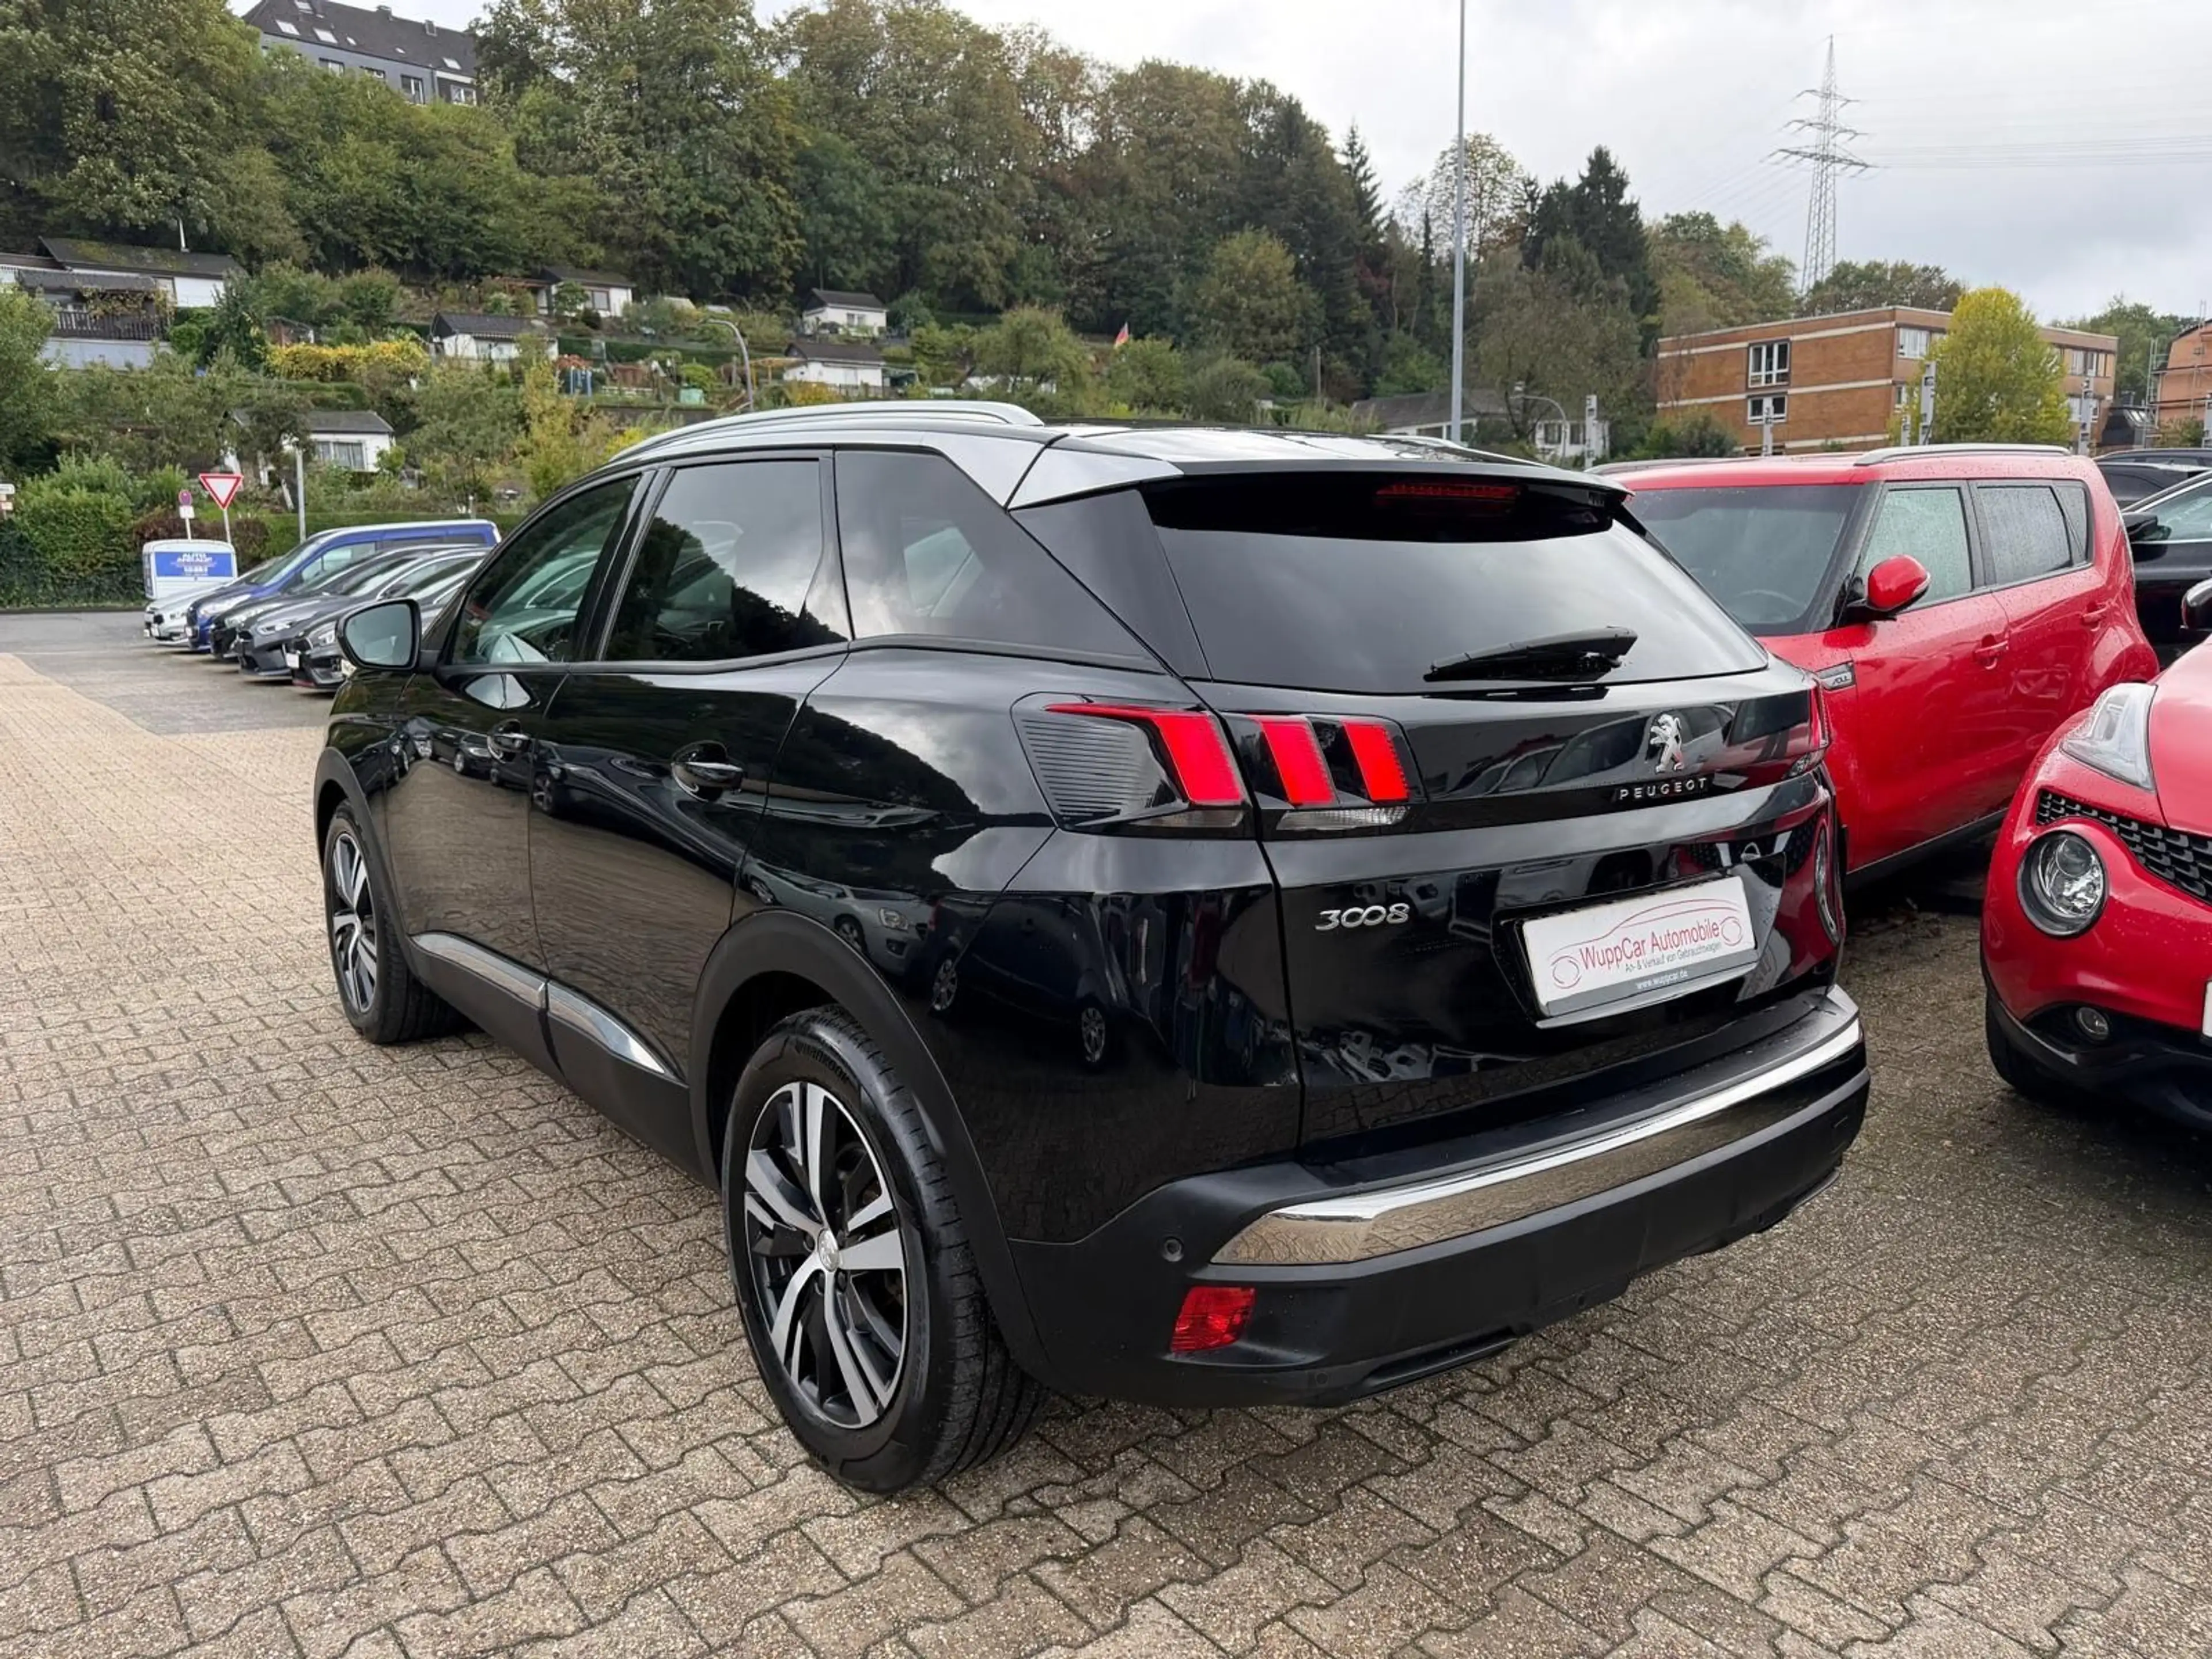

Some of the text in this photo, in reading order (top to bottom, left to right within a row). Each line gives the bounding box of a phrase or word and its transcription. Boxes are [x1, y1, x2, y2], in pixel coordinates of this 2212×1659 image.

[1619, 778, 1707, 800] PEUGEOT
[1315, 903, 1410, 931] 3008
[1580, 918, 1720, 970] WuppCar Automobile
